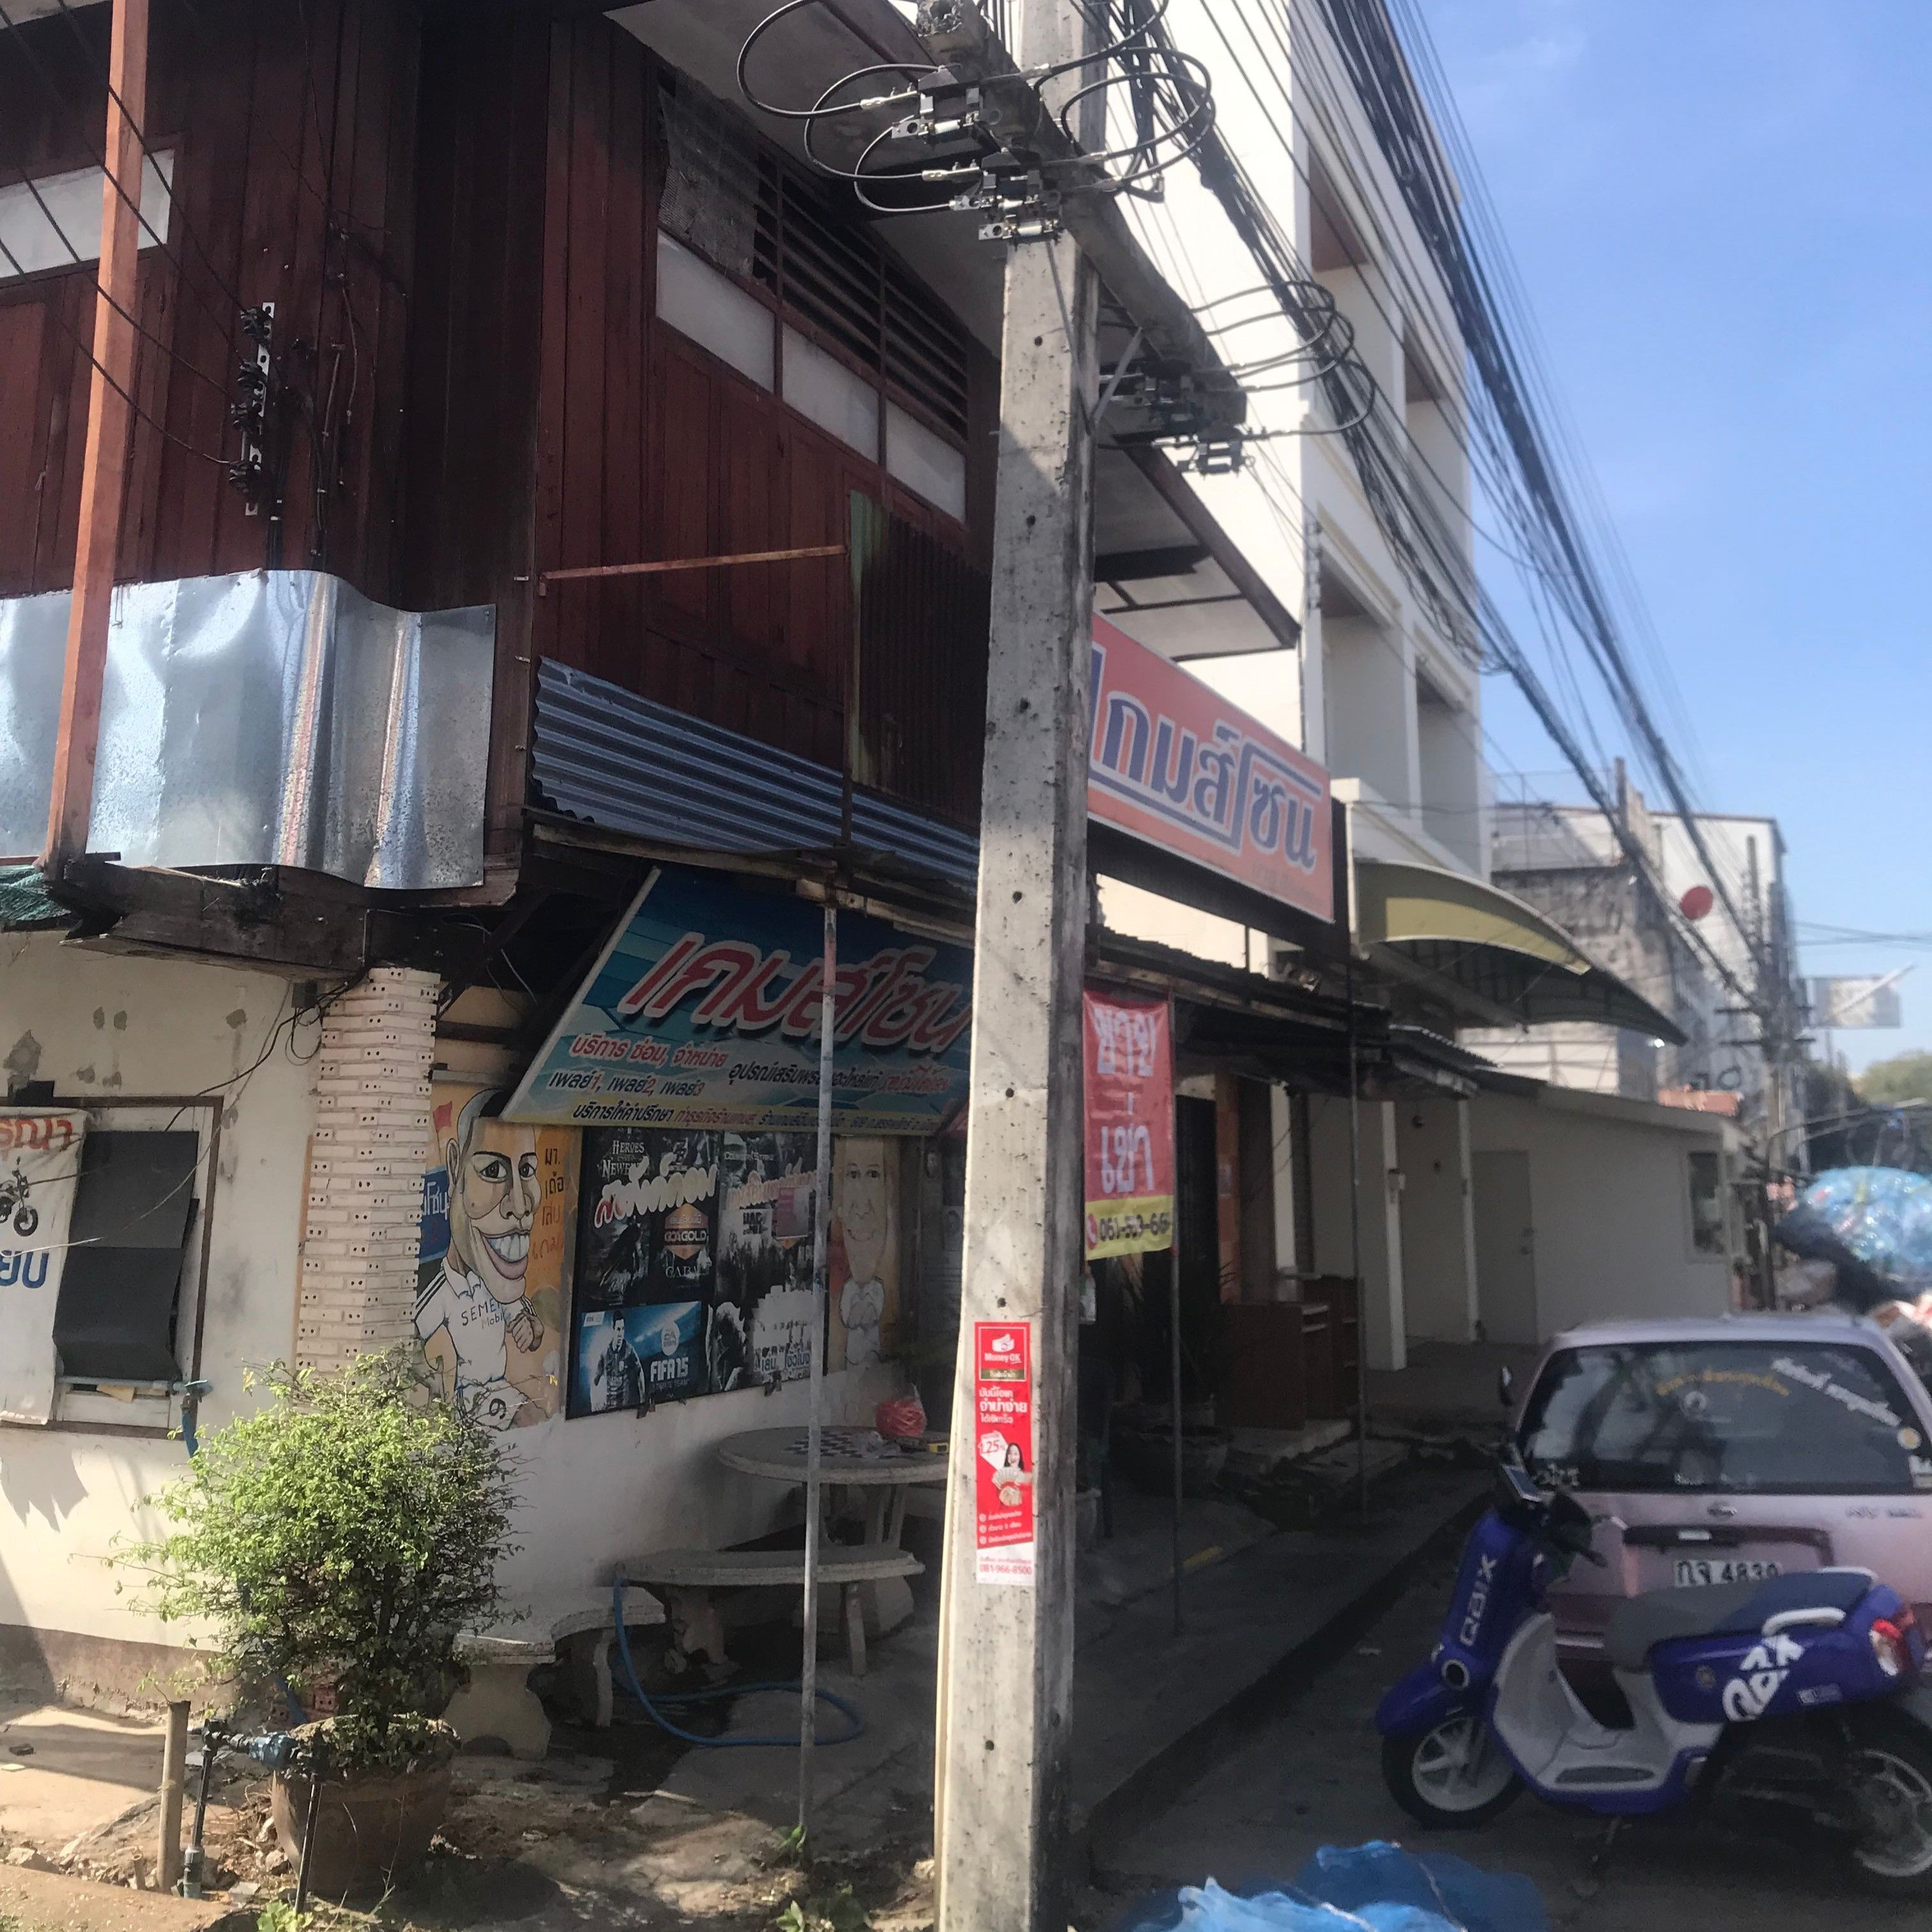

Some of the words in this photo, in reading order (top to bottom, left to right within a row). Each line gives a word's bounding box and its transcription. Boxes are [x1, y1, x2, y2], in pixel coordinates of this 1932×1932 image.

[612, 1140, 645, 1155] HEROES
[650, 1358, 675, 1383] FIFA
[675, 1356, 689, 1378] 15
